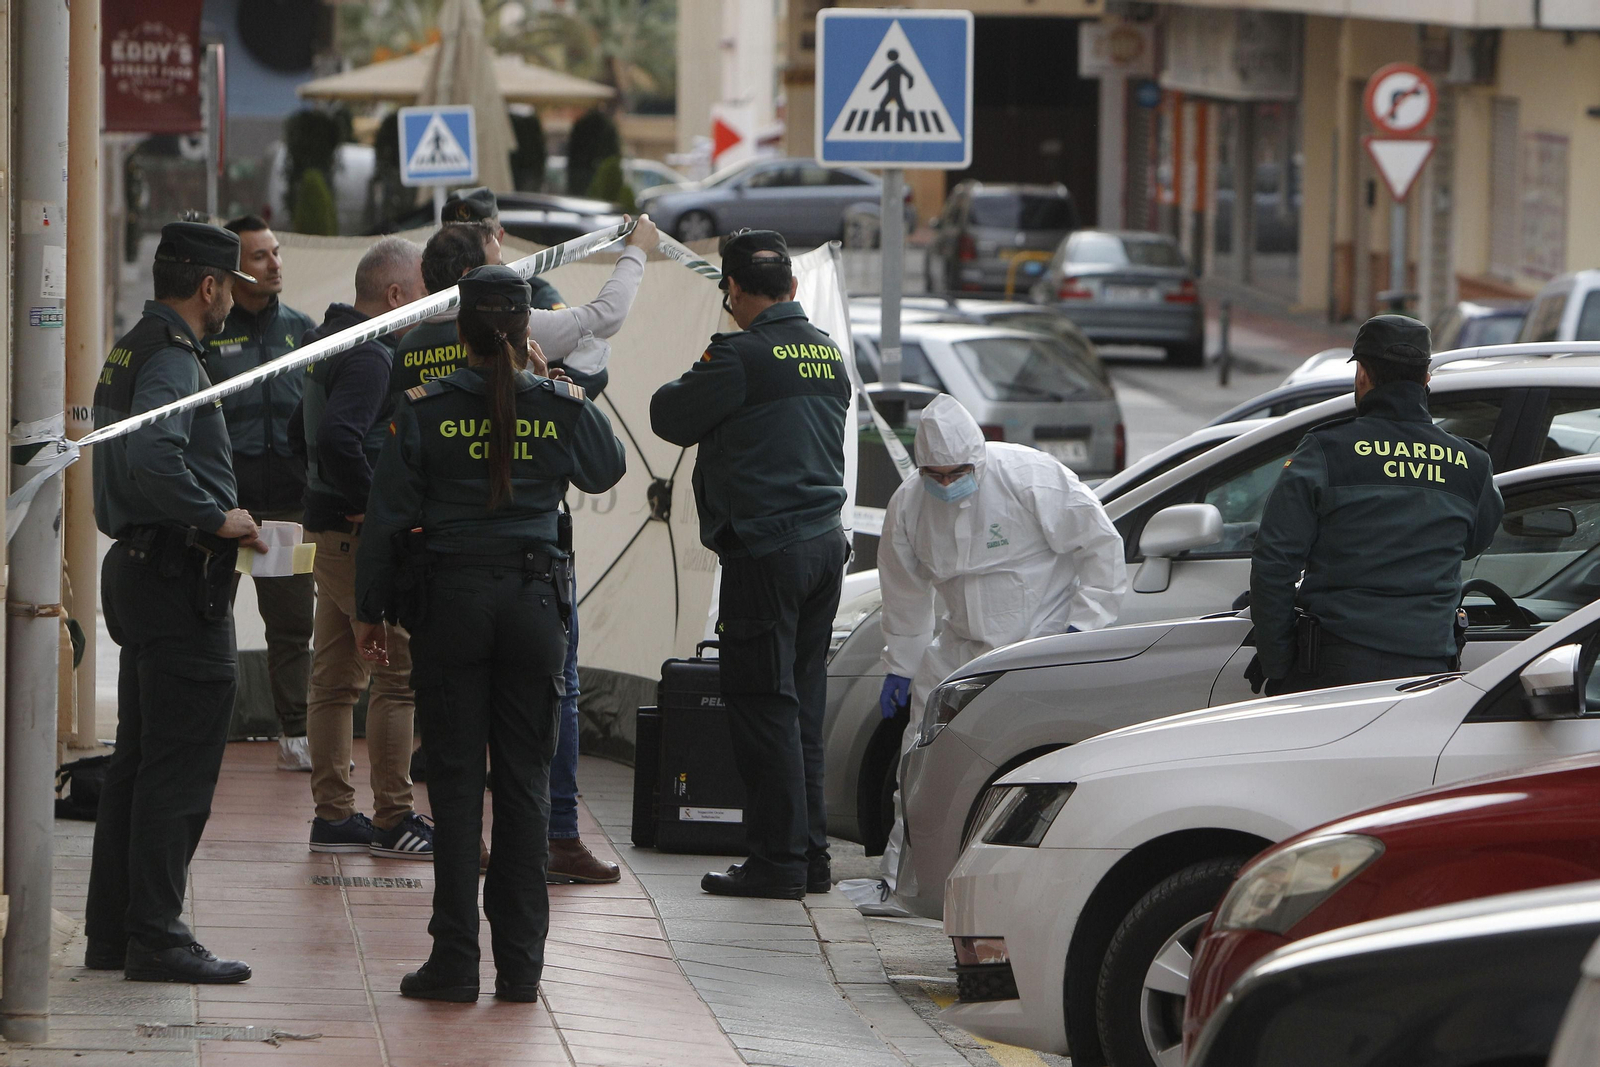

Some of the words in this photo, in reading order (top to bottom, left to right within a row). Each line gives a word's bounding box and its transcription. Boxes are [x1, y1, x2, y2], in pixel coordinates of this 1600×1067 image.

[111, 40, 193, 65] EDDY'S
[772, 343, 843, 363] GUARDIA
[798, 362, 836, 380] CIVIL
[72, 406, 88, 421] NO
[439, 419, 558, 440] GUADIA
[468, 441, 533, 460] CIIL
[1354, 440, 1469, 470] GUARDIA
[1383, 460, 1446, 483] CIVIL
